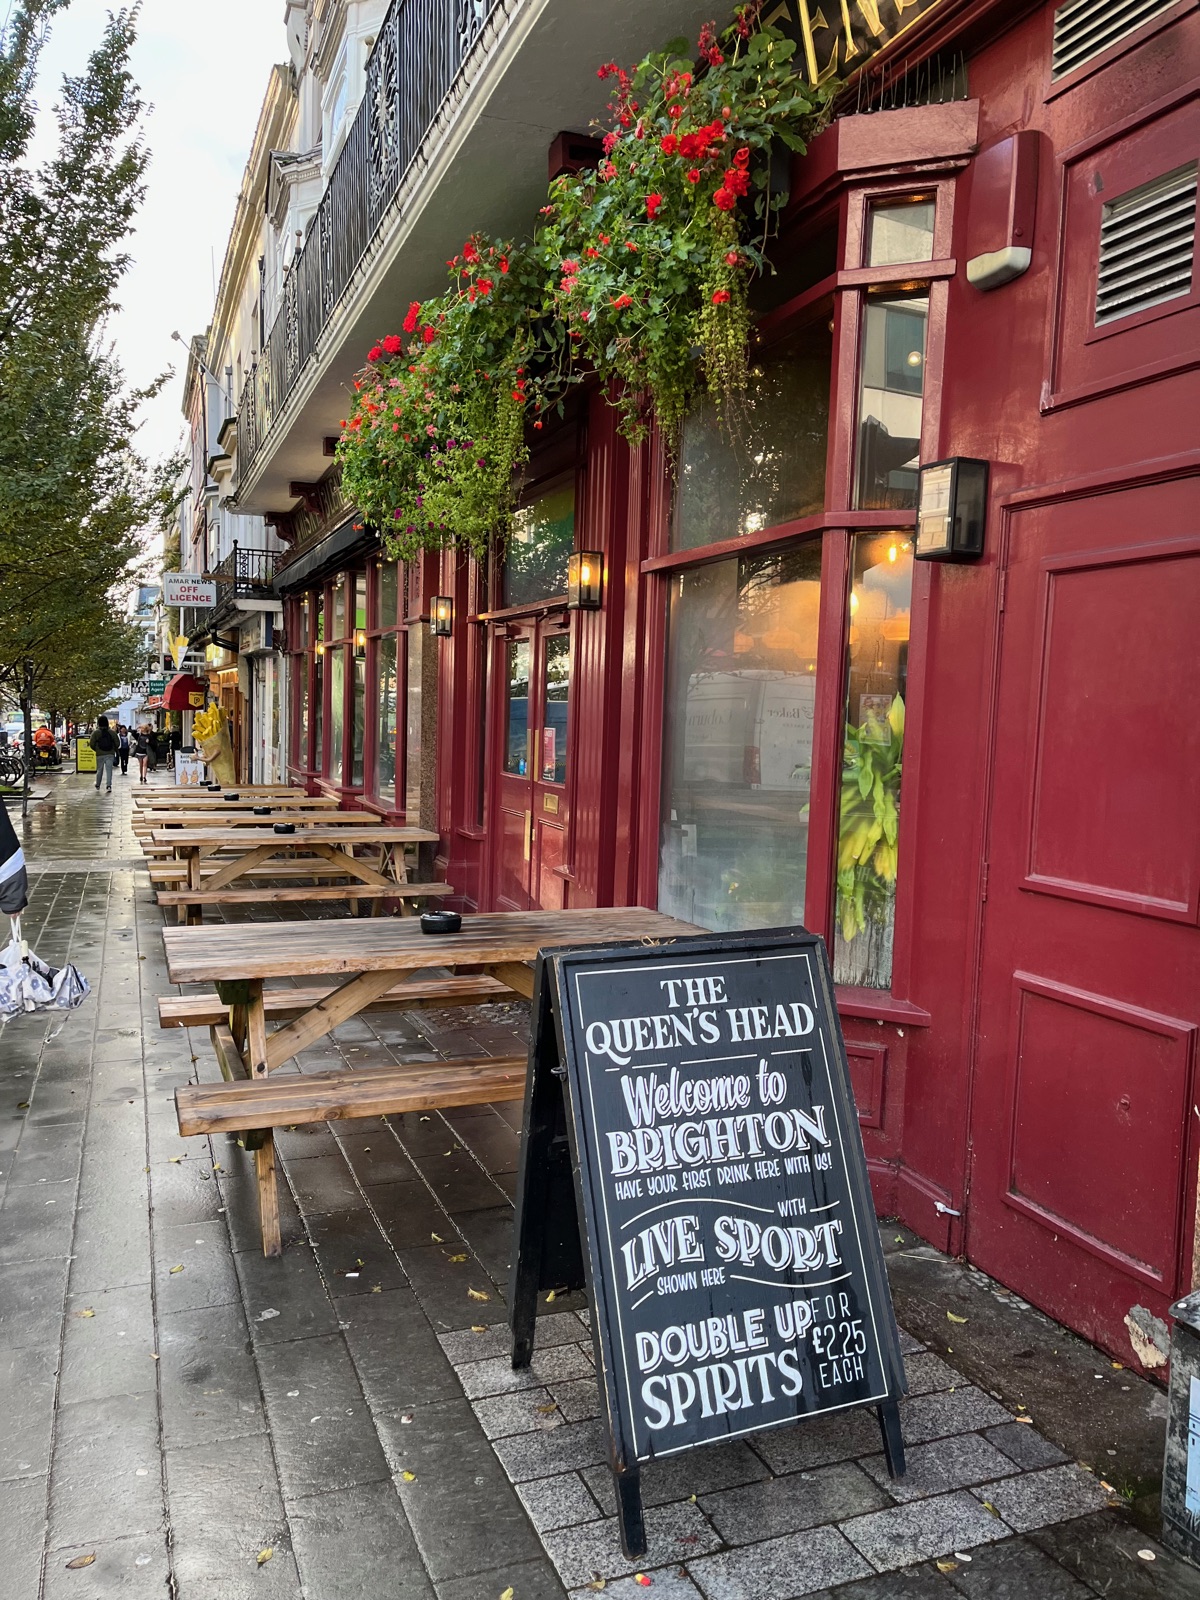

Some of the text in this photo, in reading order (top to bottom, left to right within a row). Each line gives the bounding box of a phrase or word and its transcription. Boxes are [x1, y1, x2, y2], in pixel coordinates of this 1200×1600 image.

[170, 594, 212, 602] LICENCE
[660, 975, 728, 1008] THE
[585, 1002, 816, 1066] QUEEN'S HEAD
[620, 1058, 788, 1129] Welcome to
[605, 1105, 832, 1177] BRIGHTON
[614, 1152, 833, 1201] HAVE YOUR FIRST DRINK HERE WITH US!
[777, 1197, 808, 1218] WITH
[620, 1214, 843, 1292] LIVE SPORT
[656, 1266, 727, 1297] SHOWN HERE
[810, 1292, 851, 1324] FOR
[634, 1300, 814, 1374] DOUBLE UP
[812, 1319, 867, 1361] £2.25
[640, 1348, 804, 1430] SPIRITS
[818, 1356, 865, 1389] EACH
